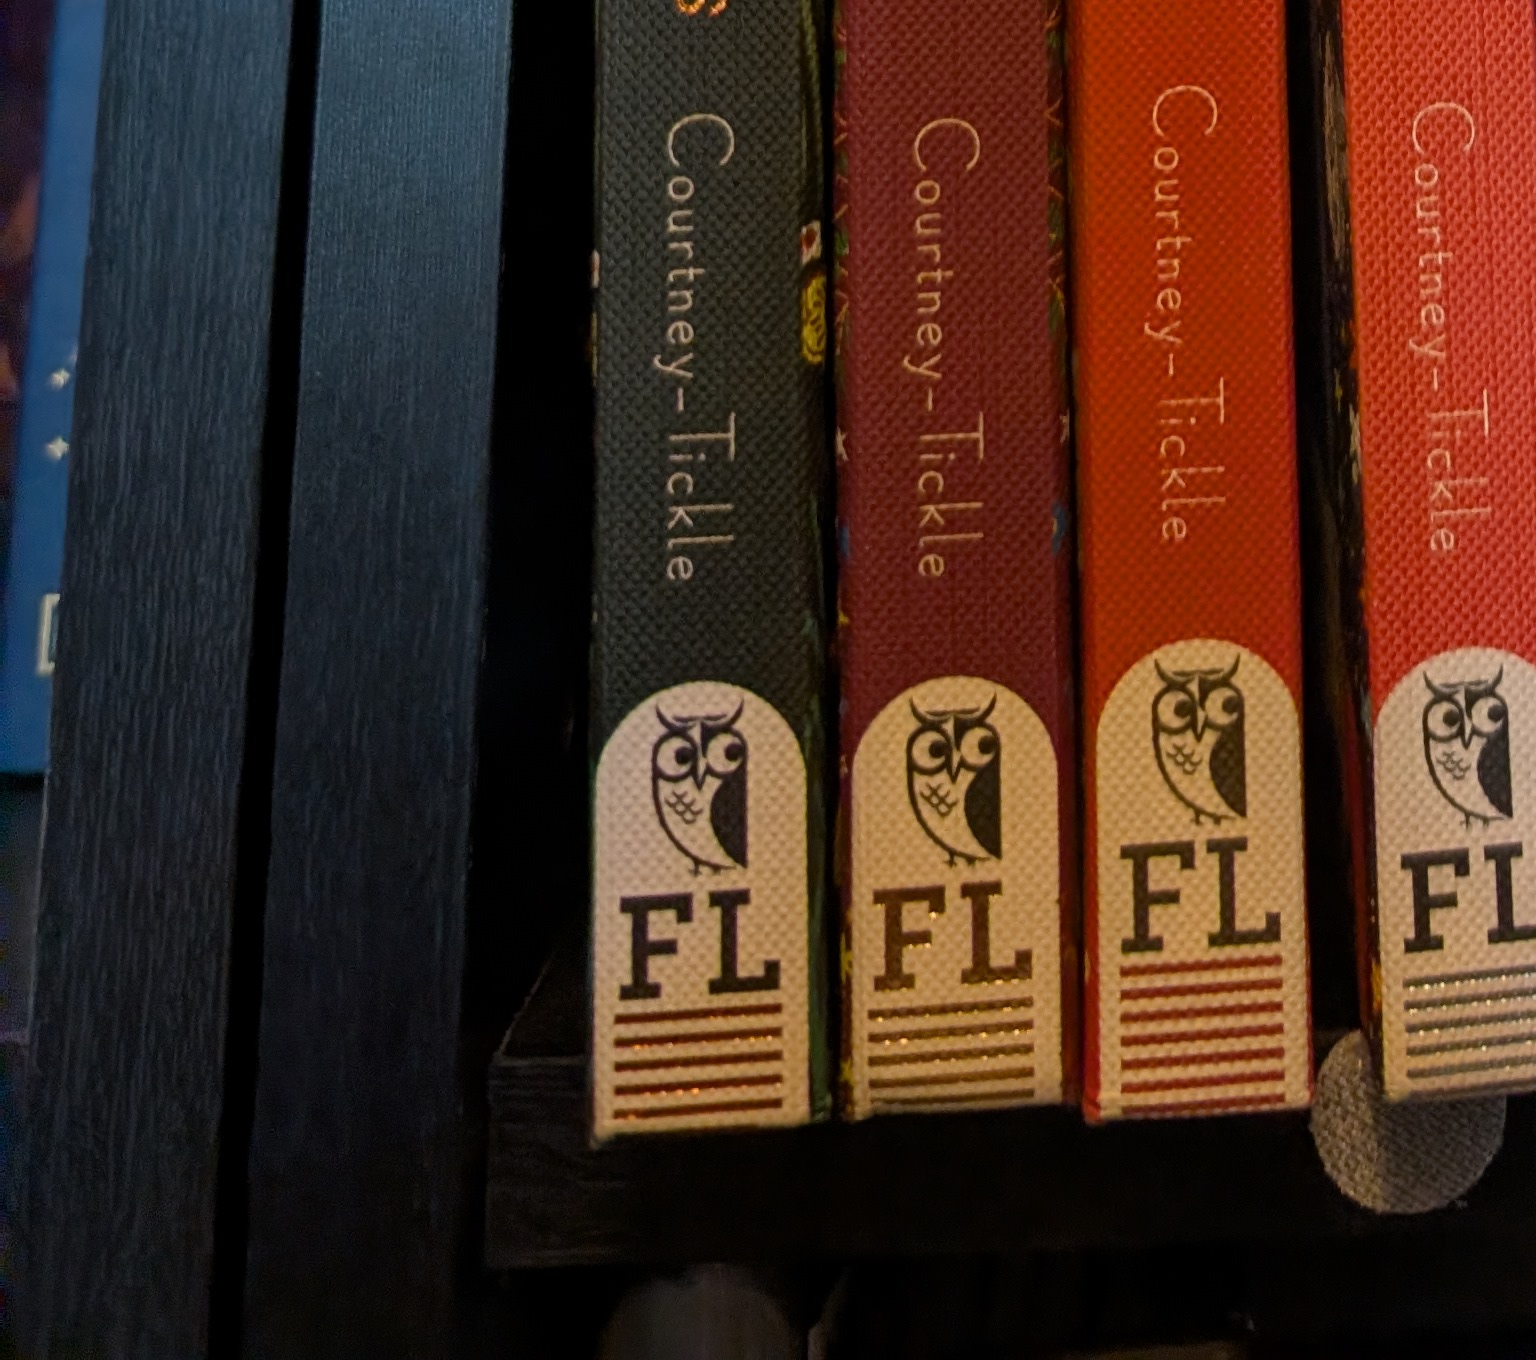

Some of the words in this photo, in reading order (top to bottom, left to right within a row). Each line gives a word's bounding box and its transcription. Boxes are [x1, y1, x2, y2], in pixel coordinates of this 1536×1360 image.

[653, 113, 737, 581] Courtney-Tickle
[903, 117, 985, 577] Courtney-Tickle
[1144, 84, 1227, 542] Courtney-Tickle
[1408, 101, 1493, 552] Courtney-Tickle
[619, 887, 782, 1002] FL
[872, 879, 1034, 992] FL
[1120, 836, 1282, 954] FL
